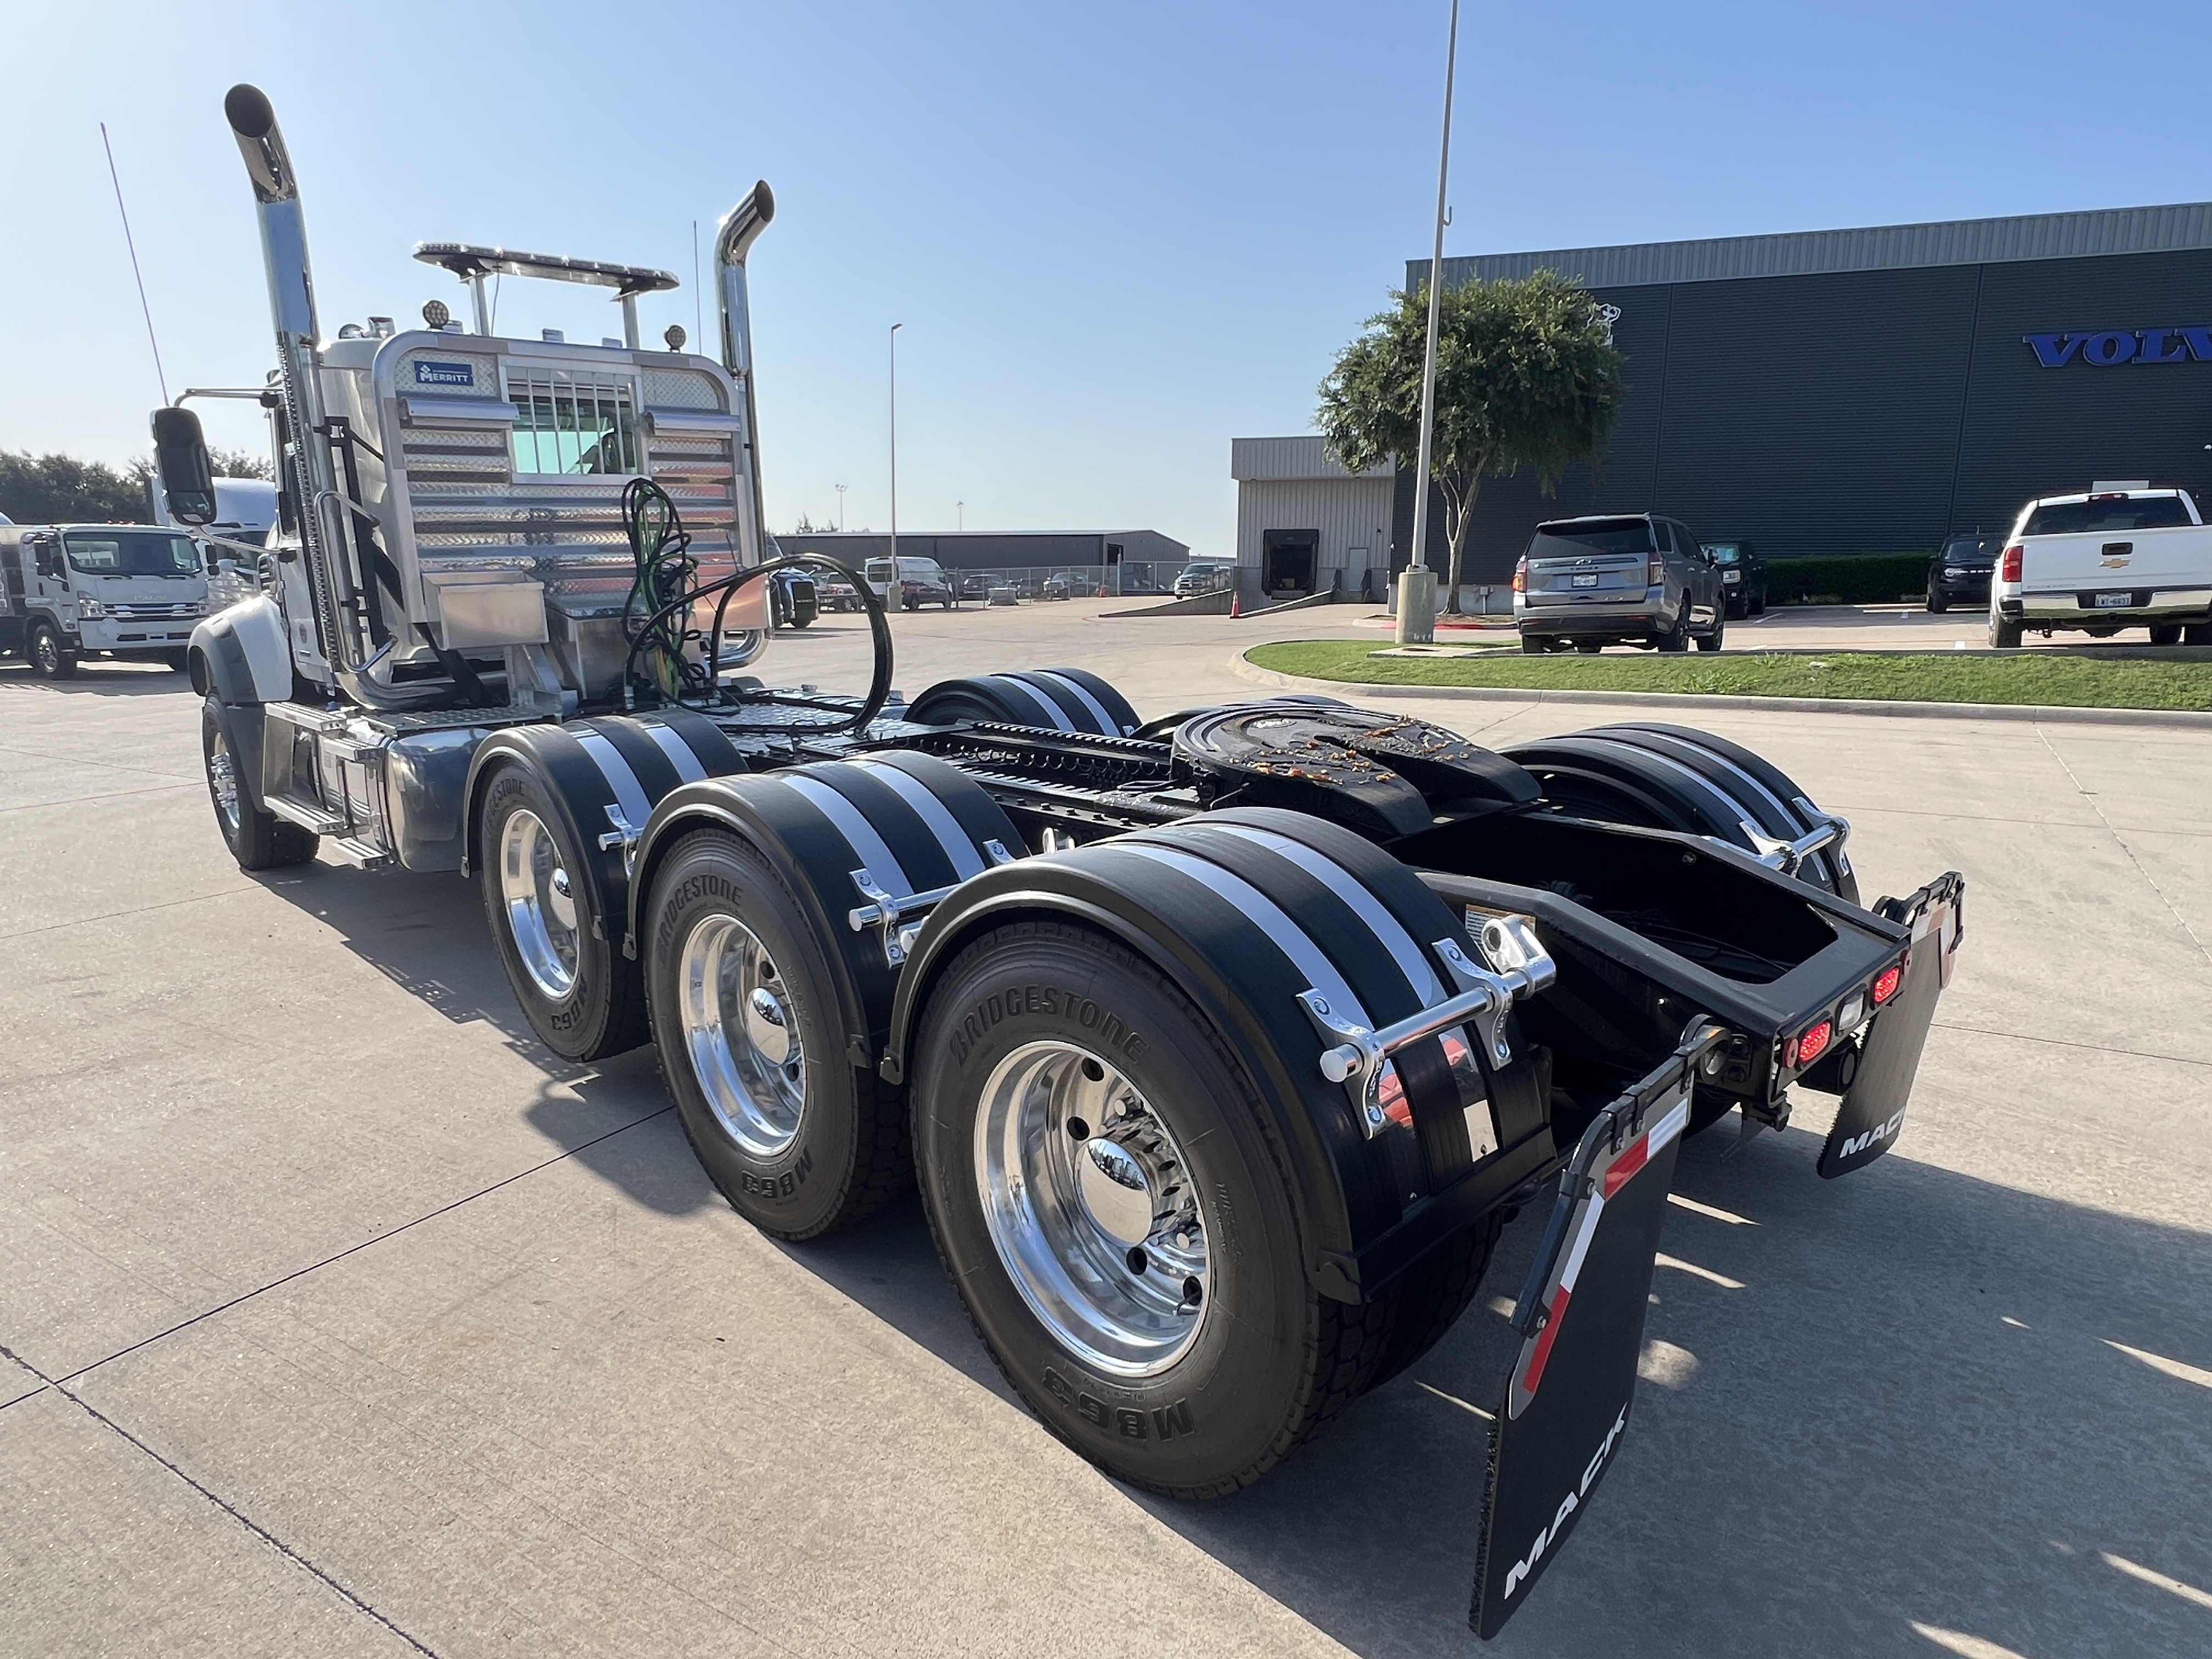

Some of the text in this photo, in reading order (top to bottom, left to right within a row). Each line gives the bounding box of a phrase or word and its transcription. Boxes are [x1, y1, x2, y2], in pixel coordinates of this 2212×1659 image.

[420, 373, 468, 382] MERRITT
[482, 778, 526, 848] IDGESTONE
[551, 973, 587, 1030] M863
[949, 984, 1150, 1068] BRIDGESTONE
[1839, 1106, 1906, 1158] MAC
[742, 1143, 813, 1199] M863
[1043, 1367, 1195, 1442] M863
[1505, 1401, 1628, 1600] MACK
